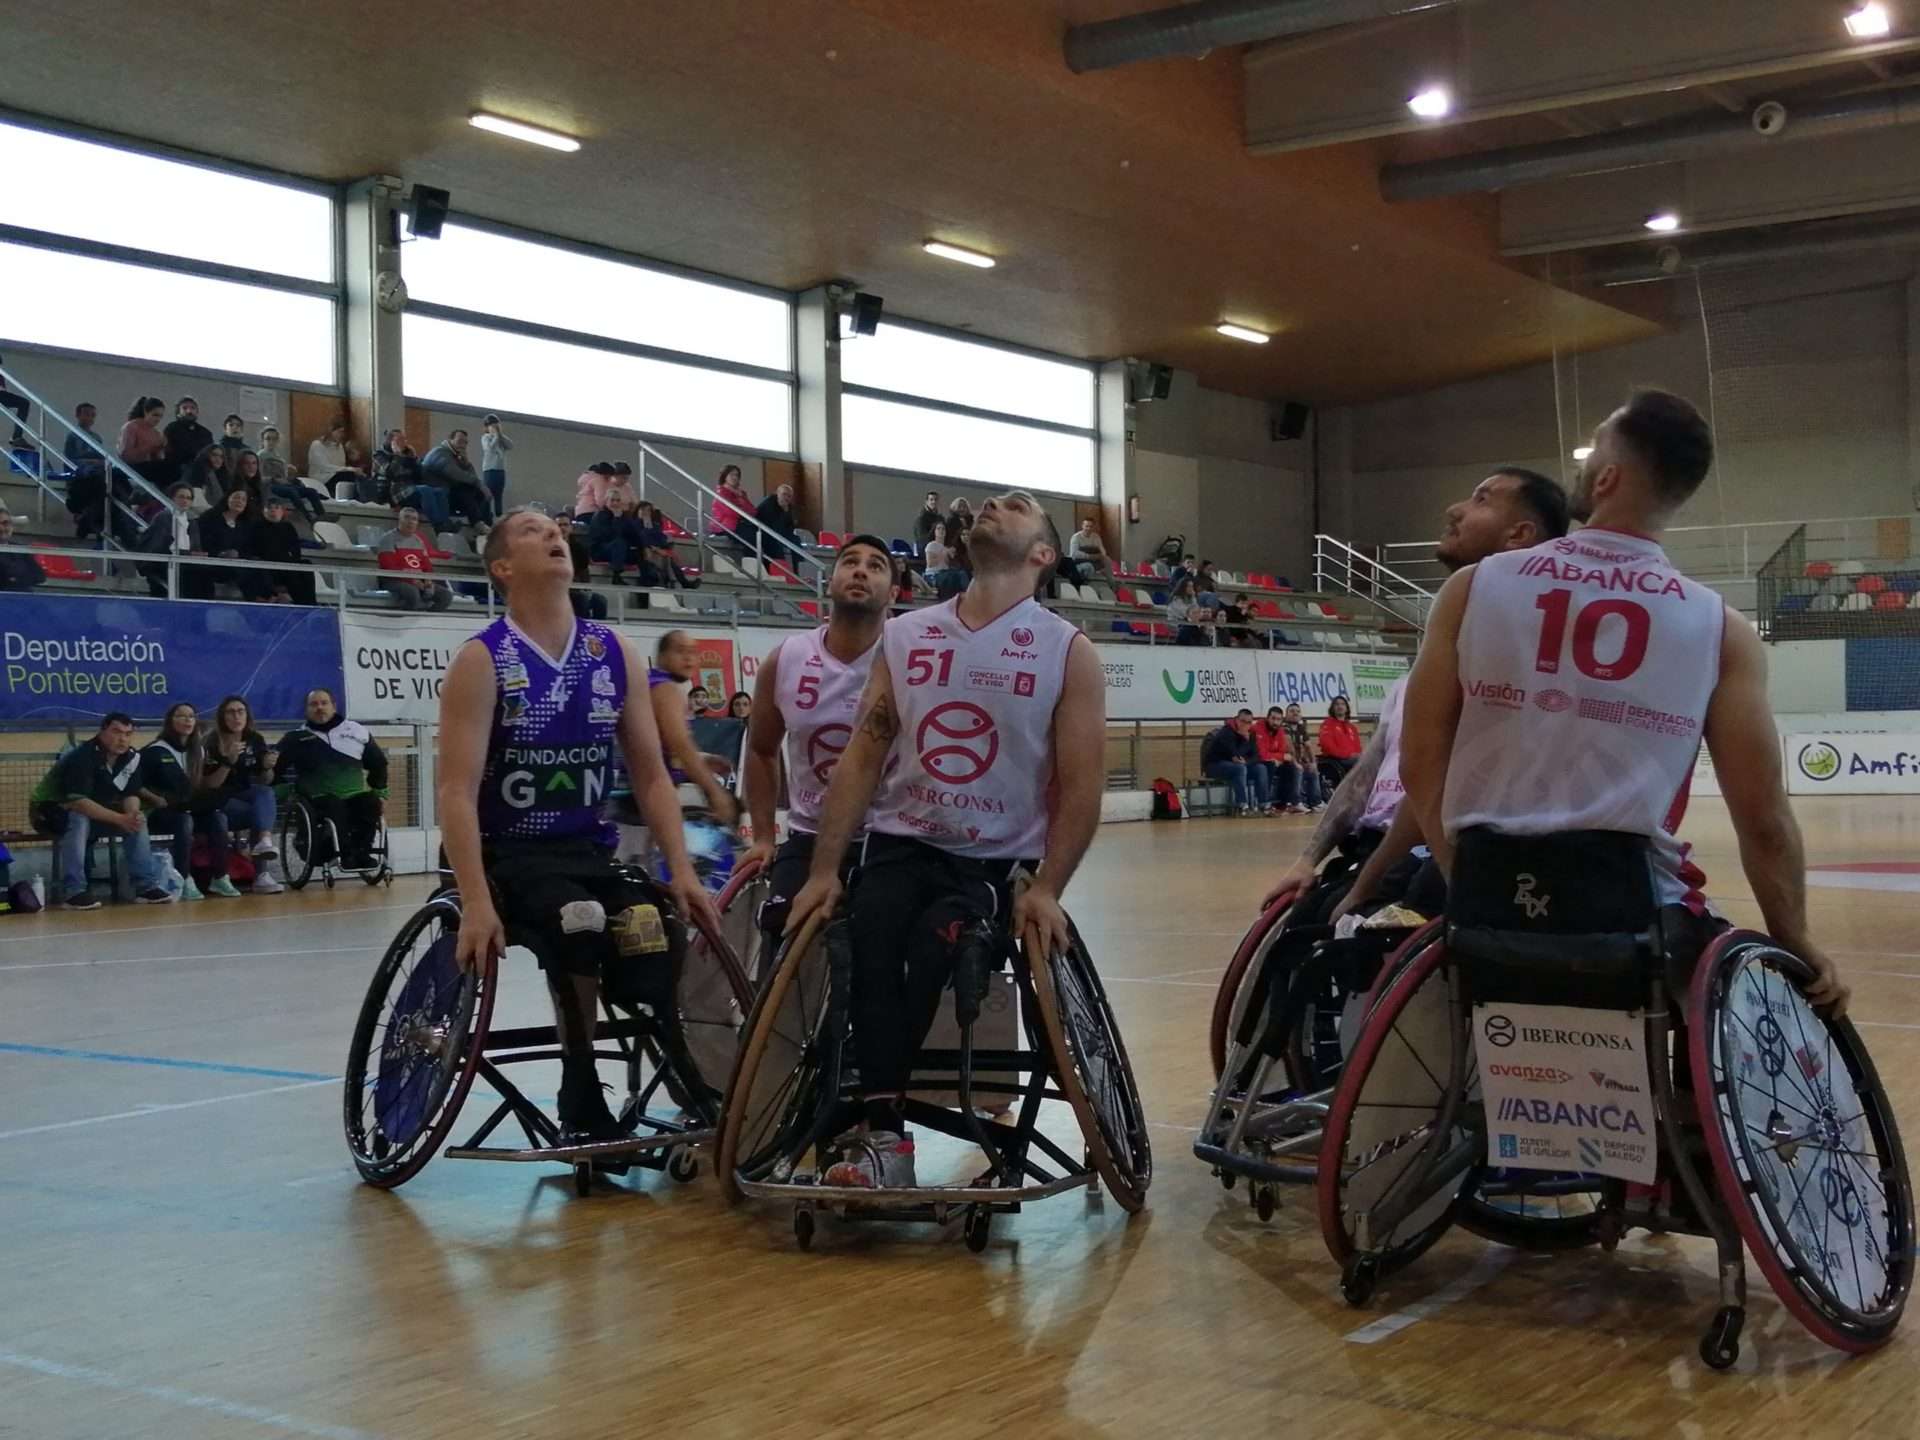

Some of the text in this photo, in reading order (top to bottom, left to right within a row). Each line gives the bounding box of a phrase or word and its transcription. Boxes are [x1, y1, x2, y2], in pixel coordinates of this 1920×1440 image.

[1535, 588, 1651, 681] 10
[4, 632, 165, 668] Deputación
[1001, 647, 1038, 660] Amfiv
[7, 664, 168, 695] Pontevedra
[906, 648, 954, 687] 51
[1198, 670, 1235, 686] GALICIA
[374, 677, 405, 699] DE
[550, 676, 569, 712] 4
[796, 675, 820, 710] 5
[1200, 687, 1248, 704] SAUDABLE
[504, 744, 608, 765] FUNDACIÓN
[1849, 752, 1920, 776] Amfi
[1522, 1026, 1633, 1051] IBERCONSA
[1489, 1063, 1557, 1080] avanza
